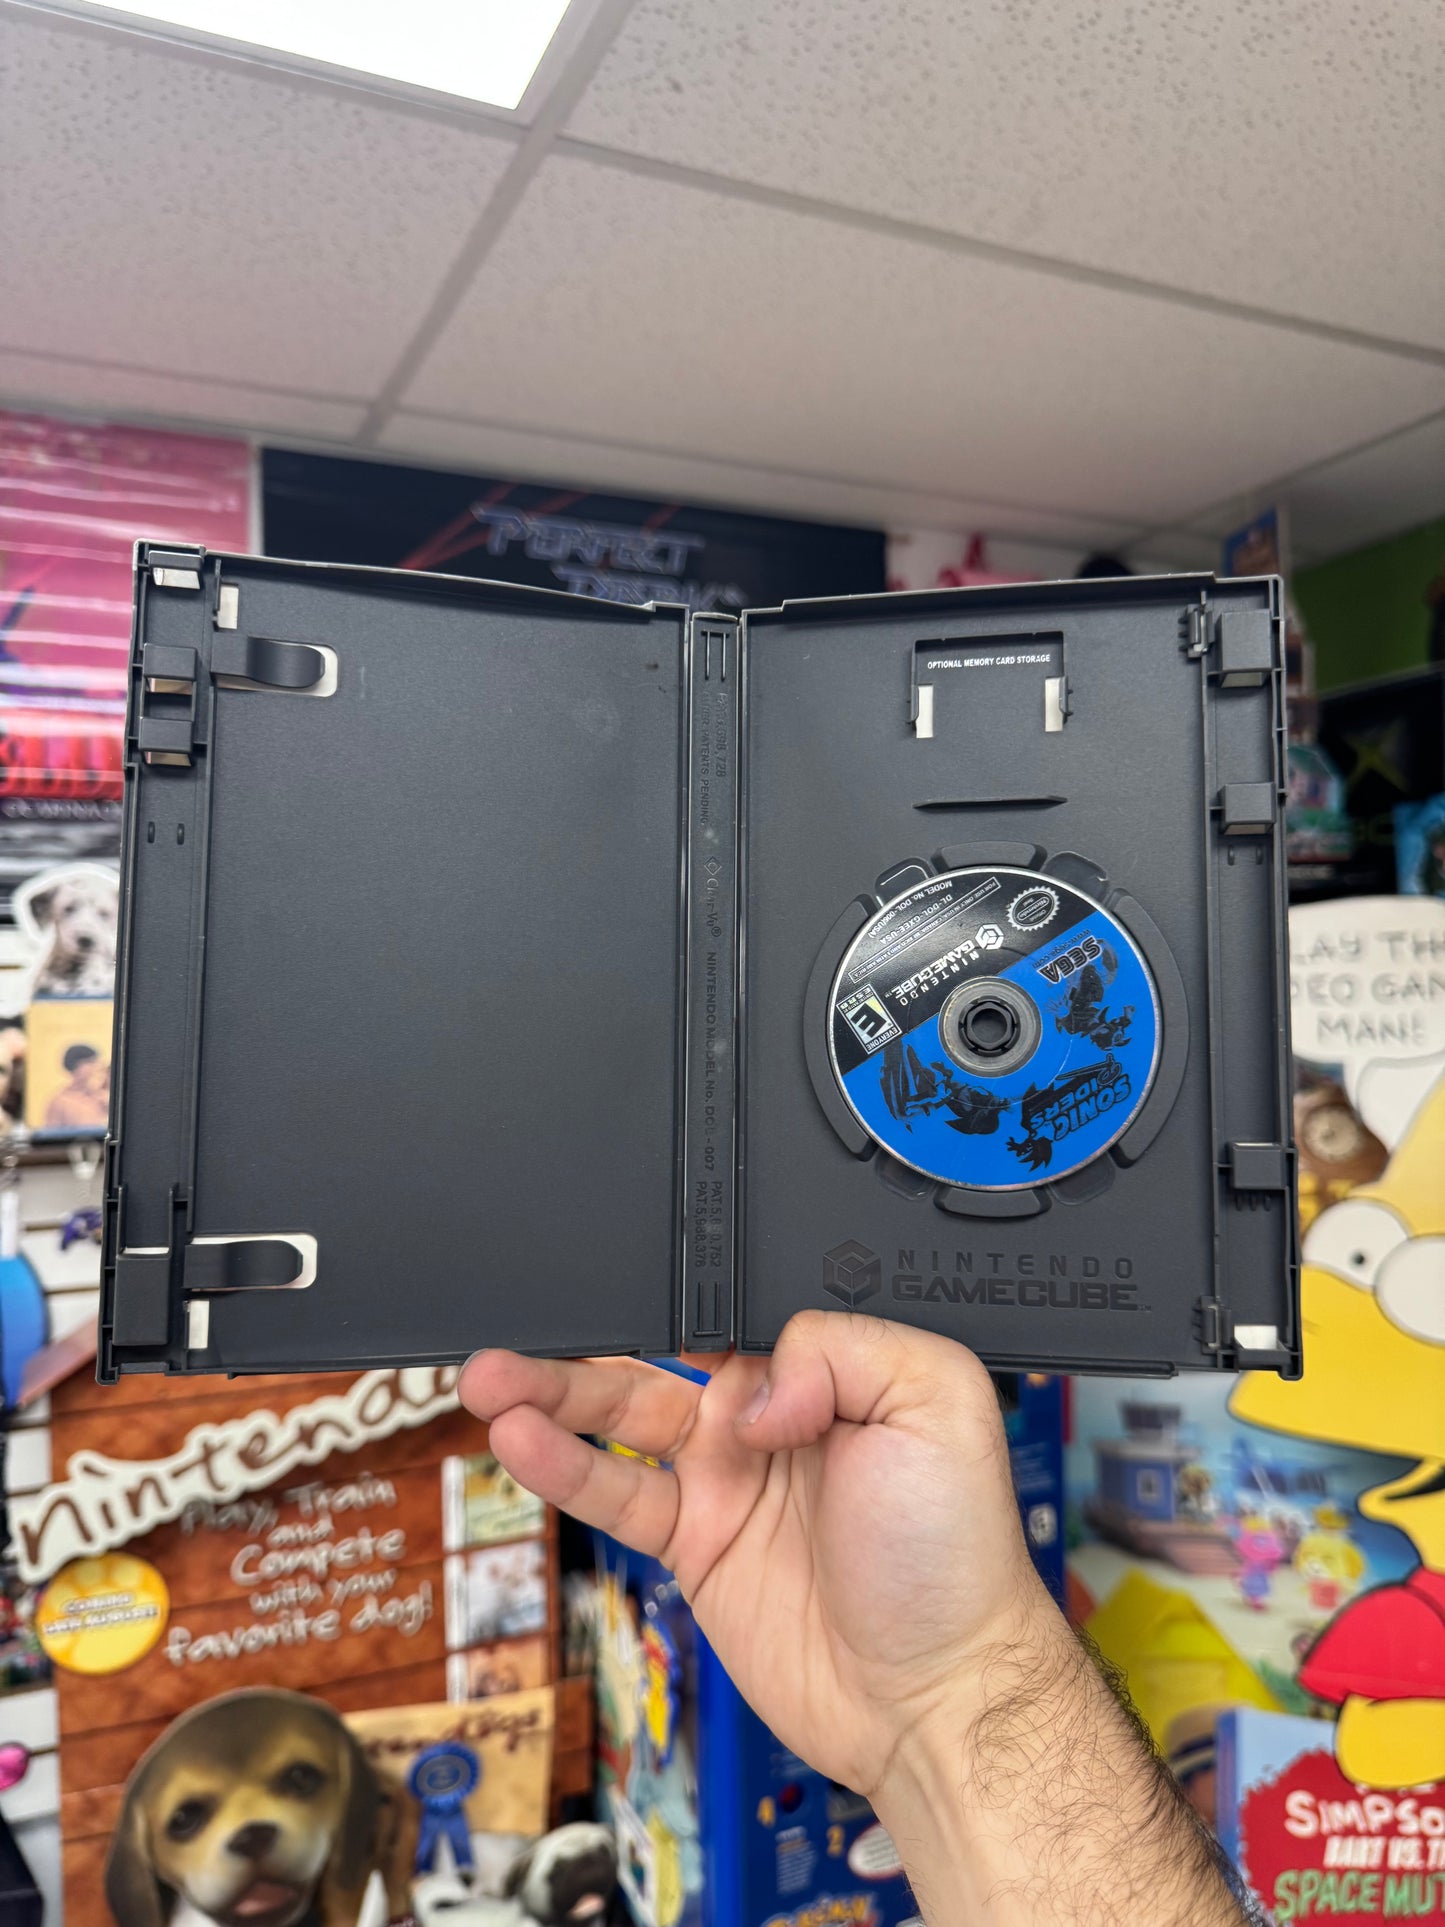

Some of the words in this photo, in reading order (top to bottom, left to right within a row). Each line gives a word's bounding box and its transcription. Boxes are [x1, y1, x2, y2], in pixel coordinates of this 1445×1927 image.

[927, 660, 962, 670] OPTIONAL
[963, 657, 994, 667] MEMORY
[996, 655, 1016, 665] CARD
[1016, 653, 1051, 664] STORAGE
[924, 879, 952, 894] MODEL
[959, 895, 974, 907] ONLY
[974, 888, 984, 897] USE
[983, 881, 995, 891] FOR
[878, 893, 953, 944] DL-DOL-GXEE-USA
[890, 939, 975, 998] GAMECUBE
[898, 950, 979, 1006] NINTENDO
[1039, 936, 1101, 981] SEGA
[706, 952, 717, 1025] NINTENDO
[850, 1002, 886, 1037] E
[865, 1026, 898, 1050] EVERYONE
[1029, 1053, 1120, 1130] RIDERS
[1053, 1074, 1131, 1140] SONIC
[896, 1249, 1134, 1279] NINTENDO
[891, 1274, 1140, 1312] GAMECUBE
[266, 1515, 334, 1547] and
[230, 1527, 405, 1586] Compete
[251, 1576, 323, 1614] with
[326, 1569, 396, 1605] your
[164, 1608, 340, 1666] favorite
[351, 1580, 433, 1636] dog!
[1274, 1869, 1381, 1921] SPACE
